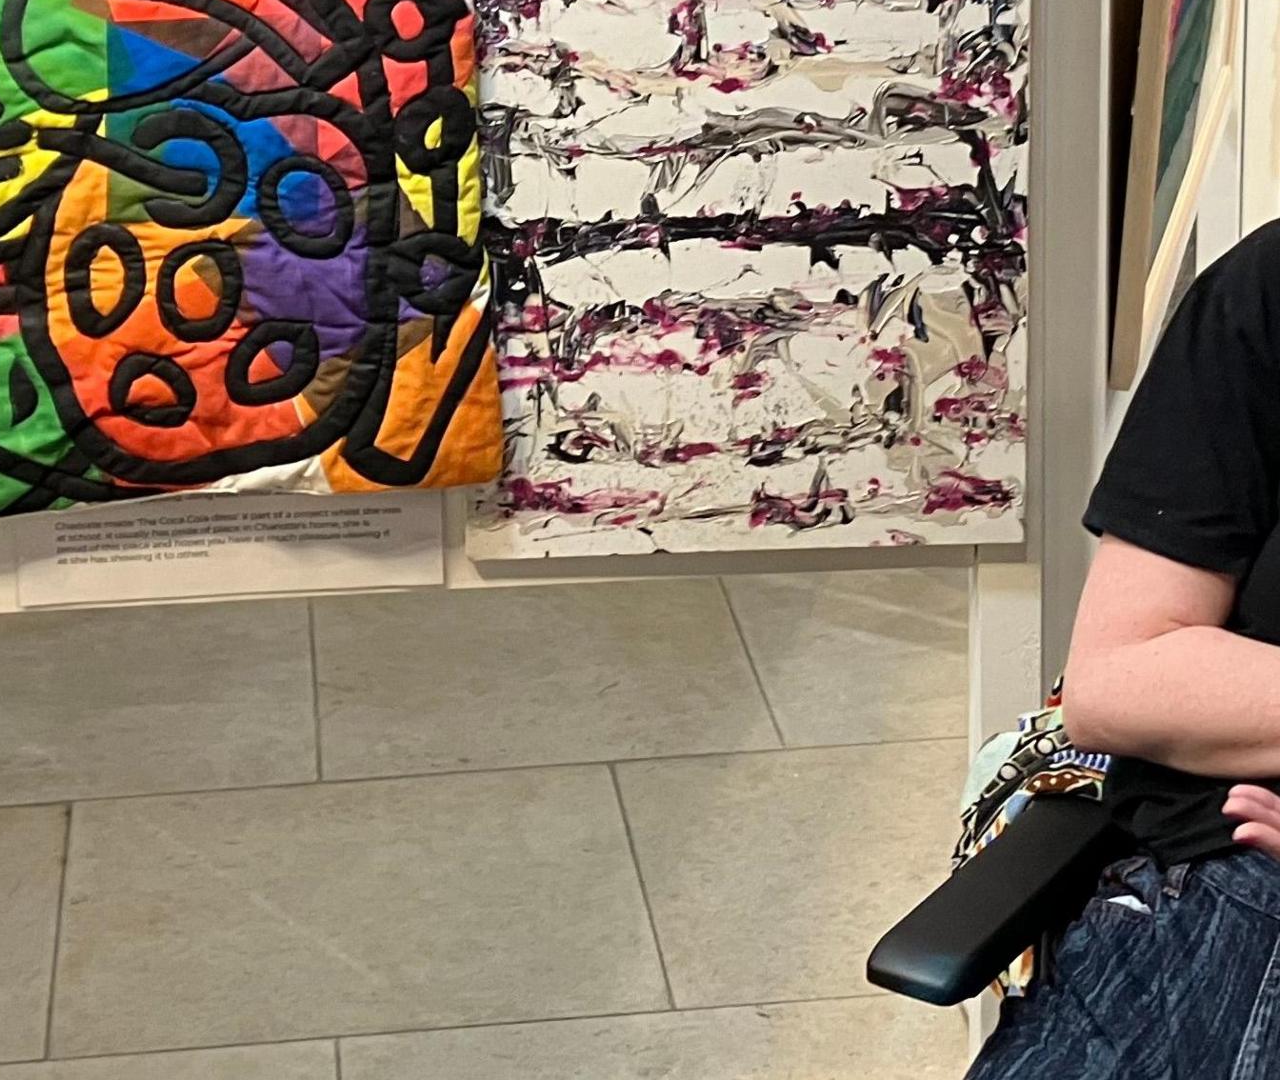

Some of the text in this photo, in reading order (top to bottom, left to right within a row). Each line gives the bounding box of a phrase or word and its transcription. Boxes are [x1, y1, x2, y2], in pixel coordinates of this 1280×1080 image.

[159, 516, 184, 525] Coca
[186, 515, 209, 523] Cola
[152, 540, 171, 548] and
